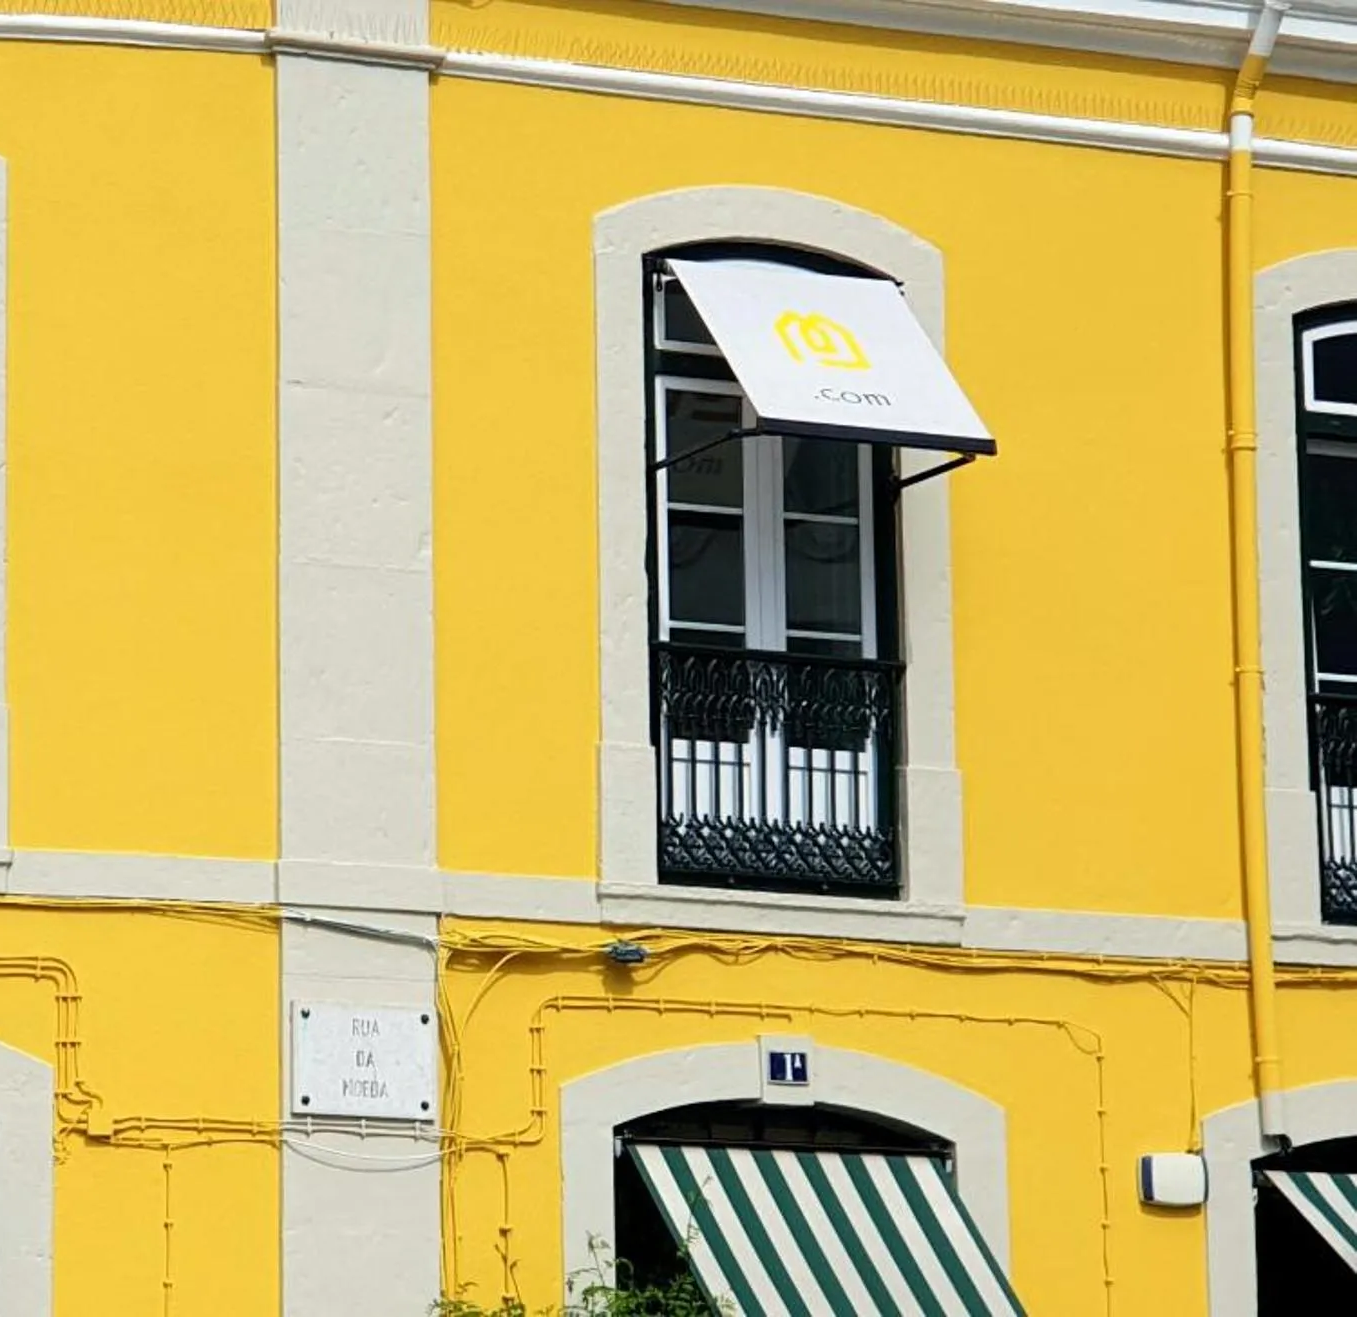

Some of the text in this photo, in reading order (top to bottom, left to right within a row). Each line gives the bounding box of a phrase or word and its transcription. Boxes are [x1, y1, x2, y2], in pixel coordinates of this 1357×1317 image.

[813, 387, 892, 407] .com
[352, 1018, 381, 1038] RUA
[355, 1050, 377, 1069] DA
[342, 1078, 389, 1099] MOEDA
